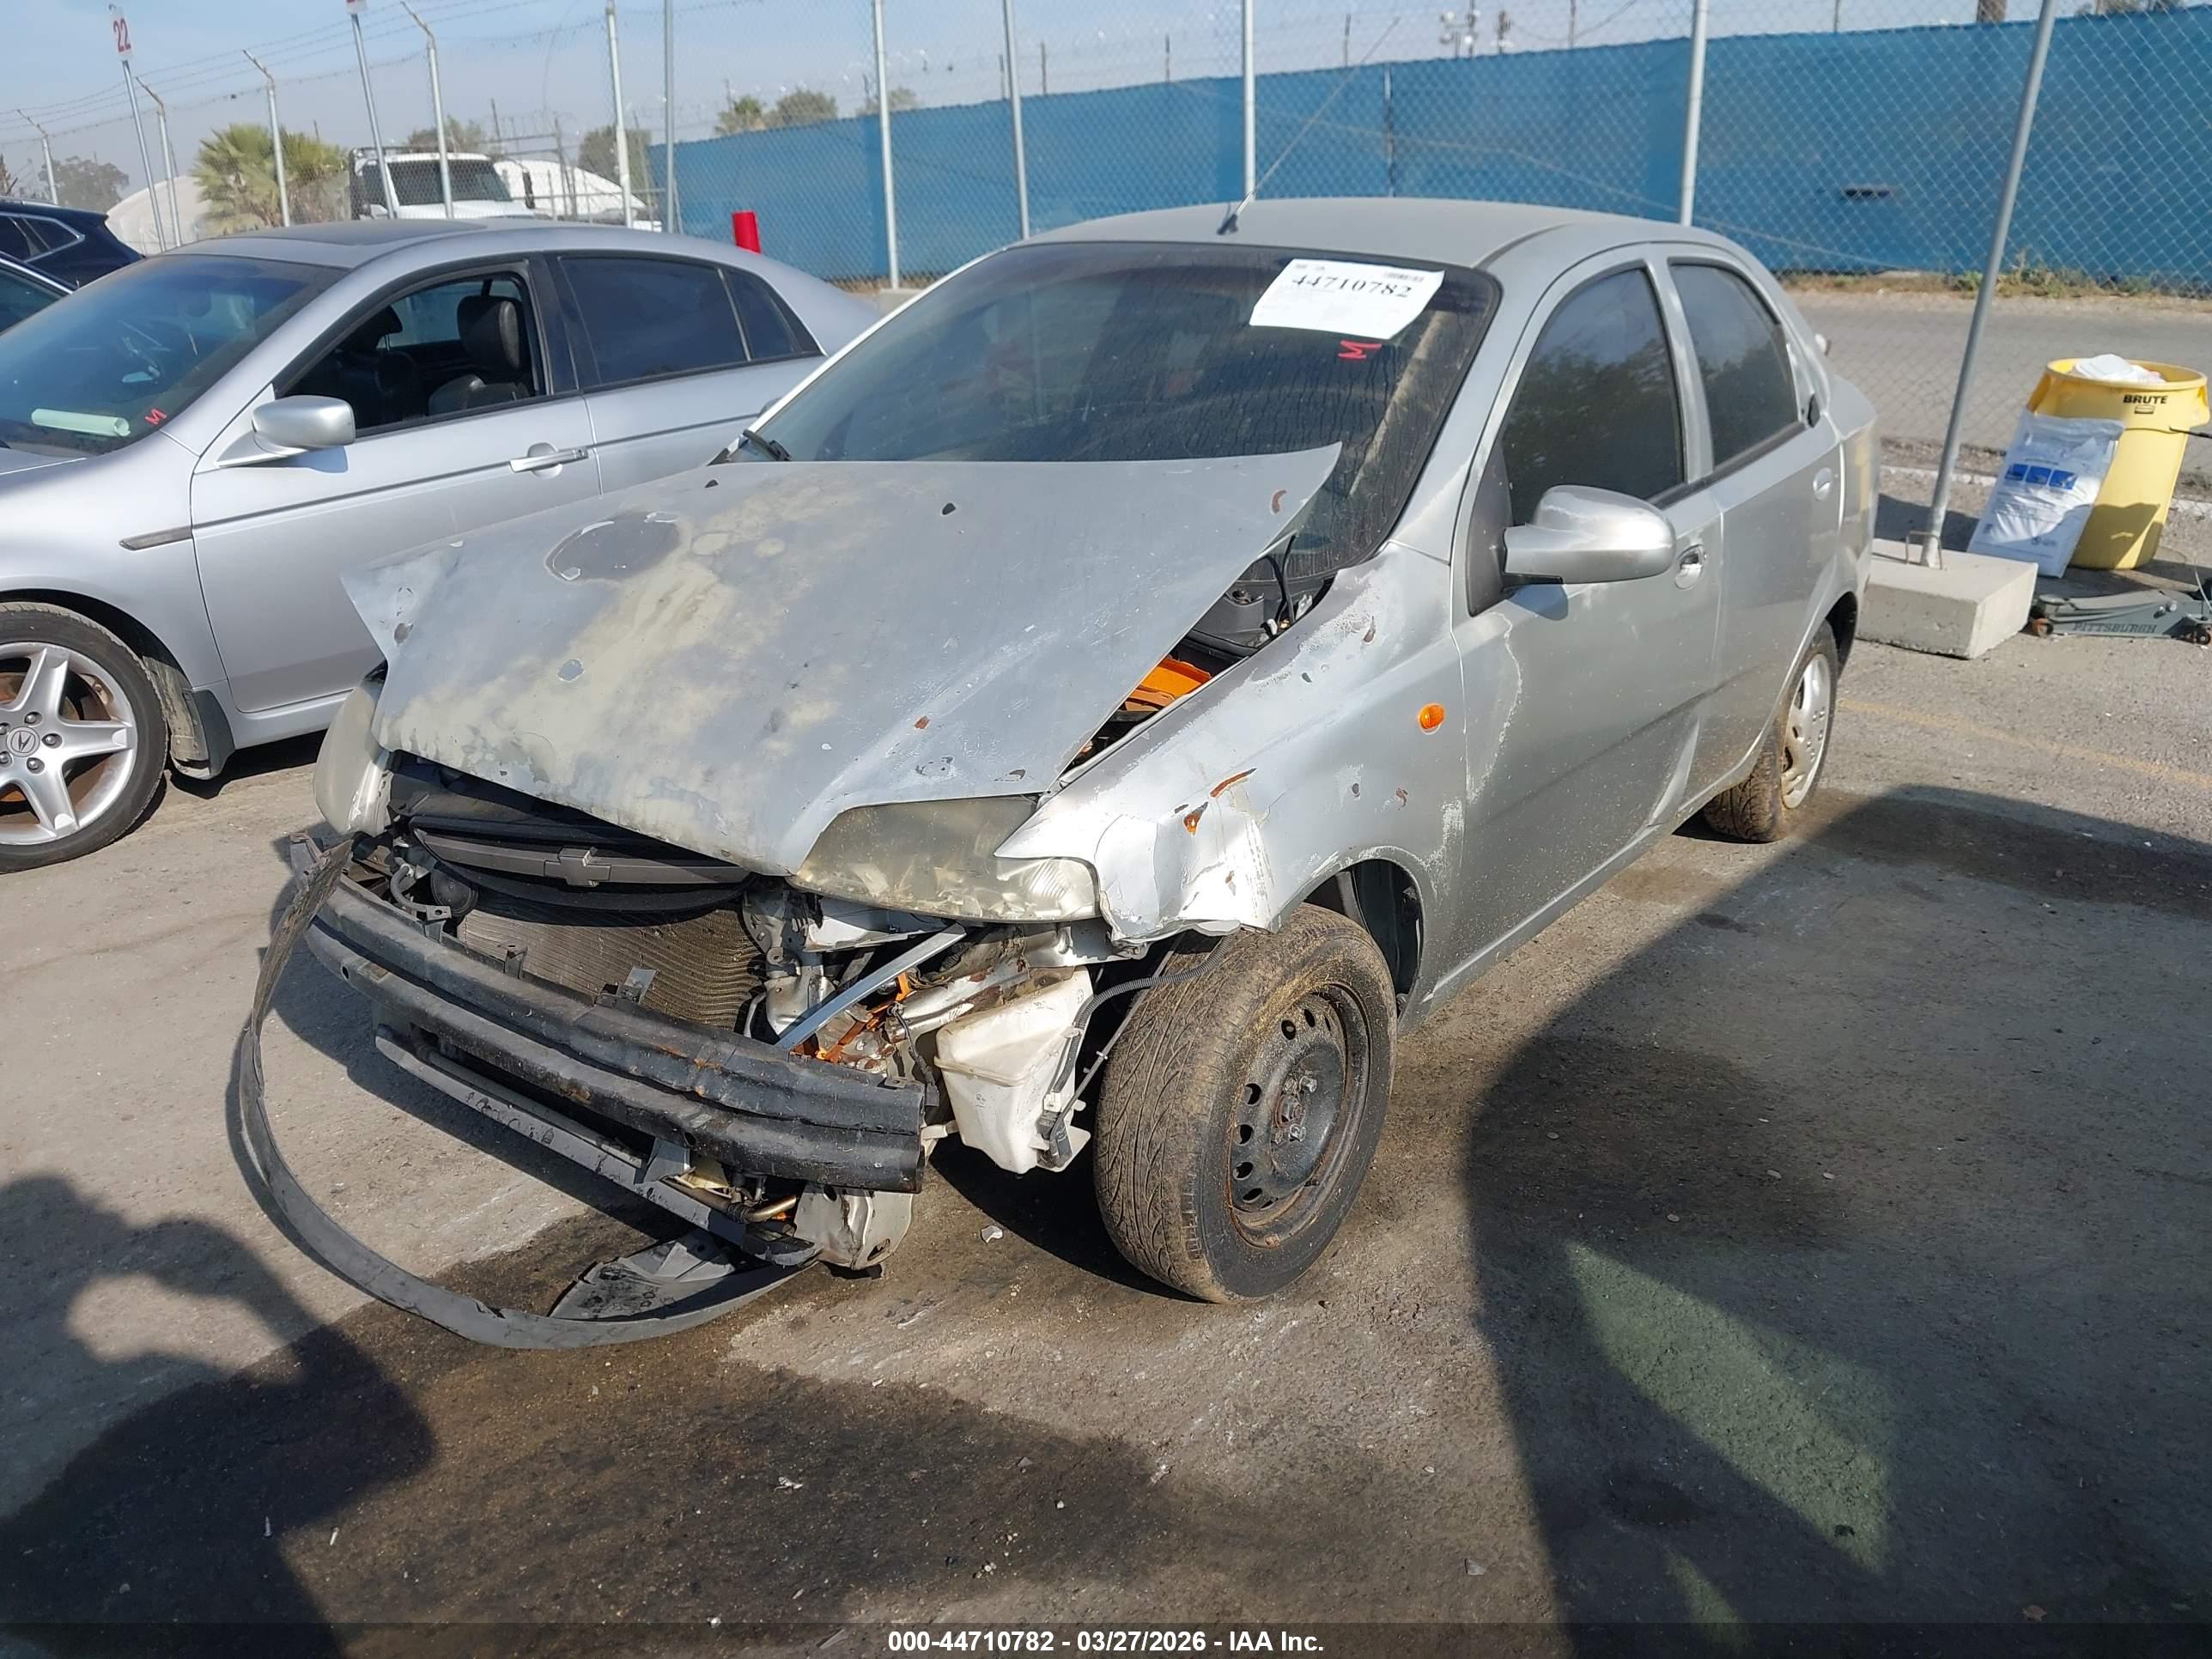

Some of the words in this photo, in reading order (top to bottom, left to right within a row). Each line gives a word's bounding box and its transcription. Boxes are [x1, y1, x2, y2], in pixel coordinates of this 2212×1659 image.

[112, 18, 131, 52] 22
[1292, 274, 1413, 298] 44710782
[2123, 394, 2168, 404] BRUTE
[2073, 622, 2157, 634] PITTSBURGH
